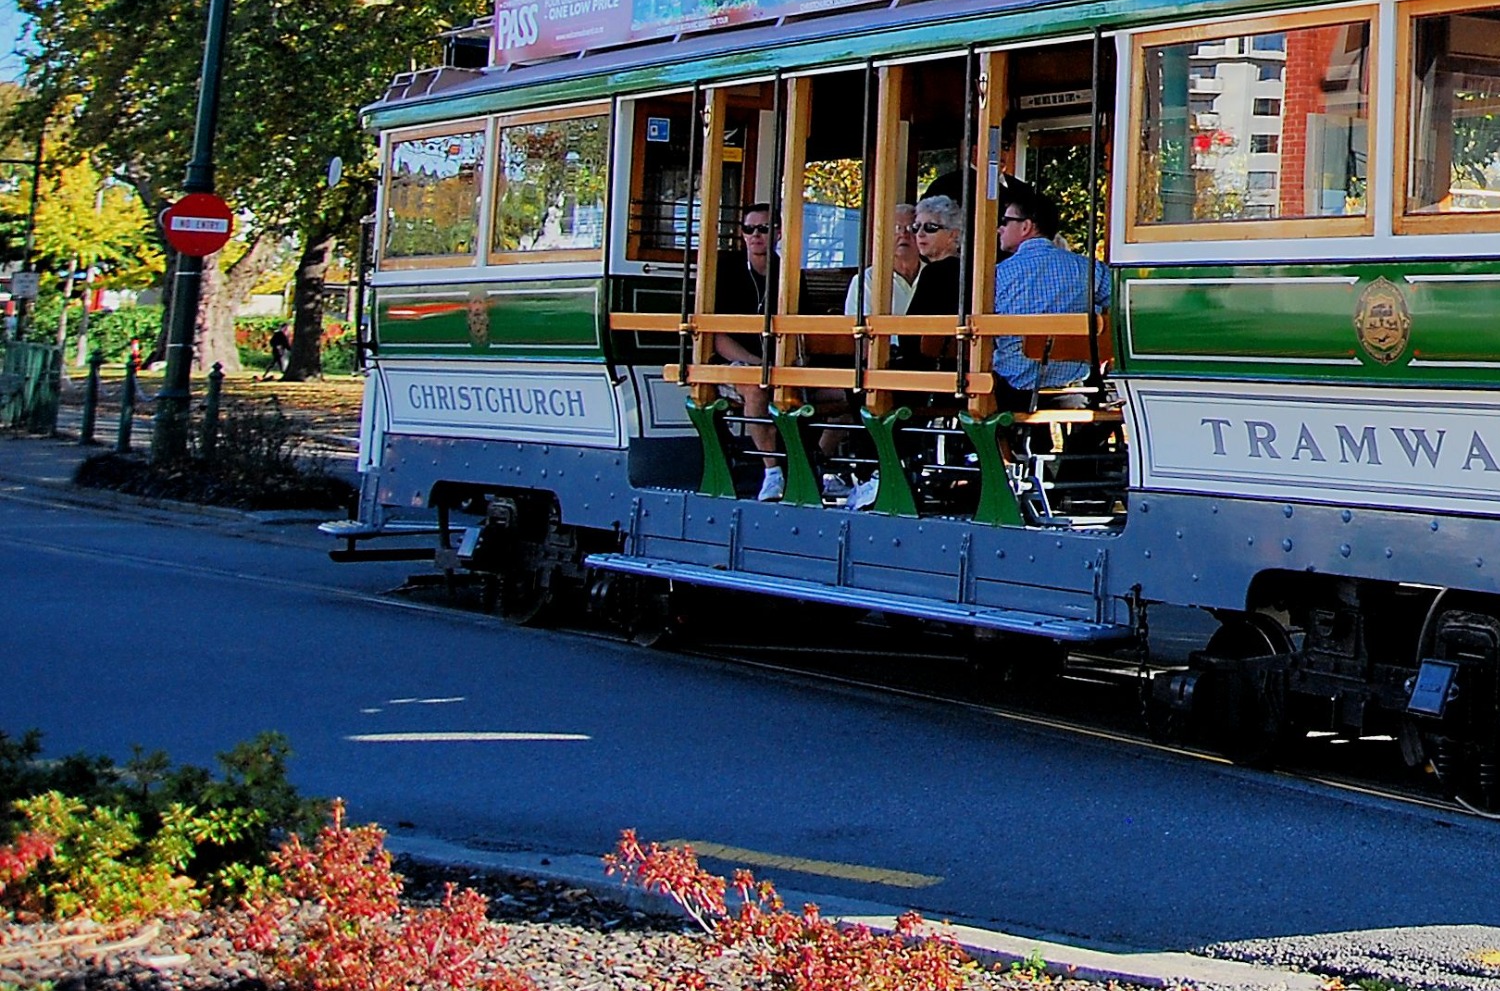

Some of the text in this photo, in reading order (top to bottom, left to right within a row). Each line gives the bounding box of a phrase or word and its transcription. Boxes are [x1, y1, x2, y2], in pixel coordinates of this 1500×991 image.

[548, 5, 569, 20] ONE
[569, 0, 591, 16] LOW
[498, 3, 539, 50] PASS
[180, 219, 219, 231] NO ENTRY
[408, 384, 586, 417] CHRISTCHURCH
